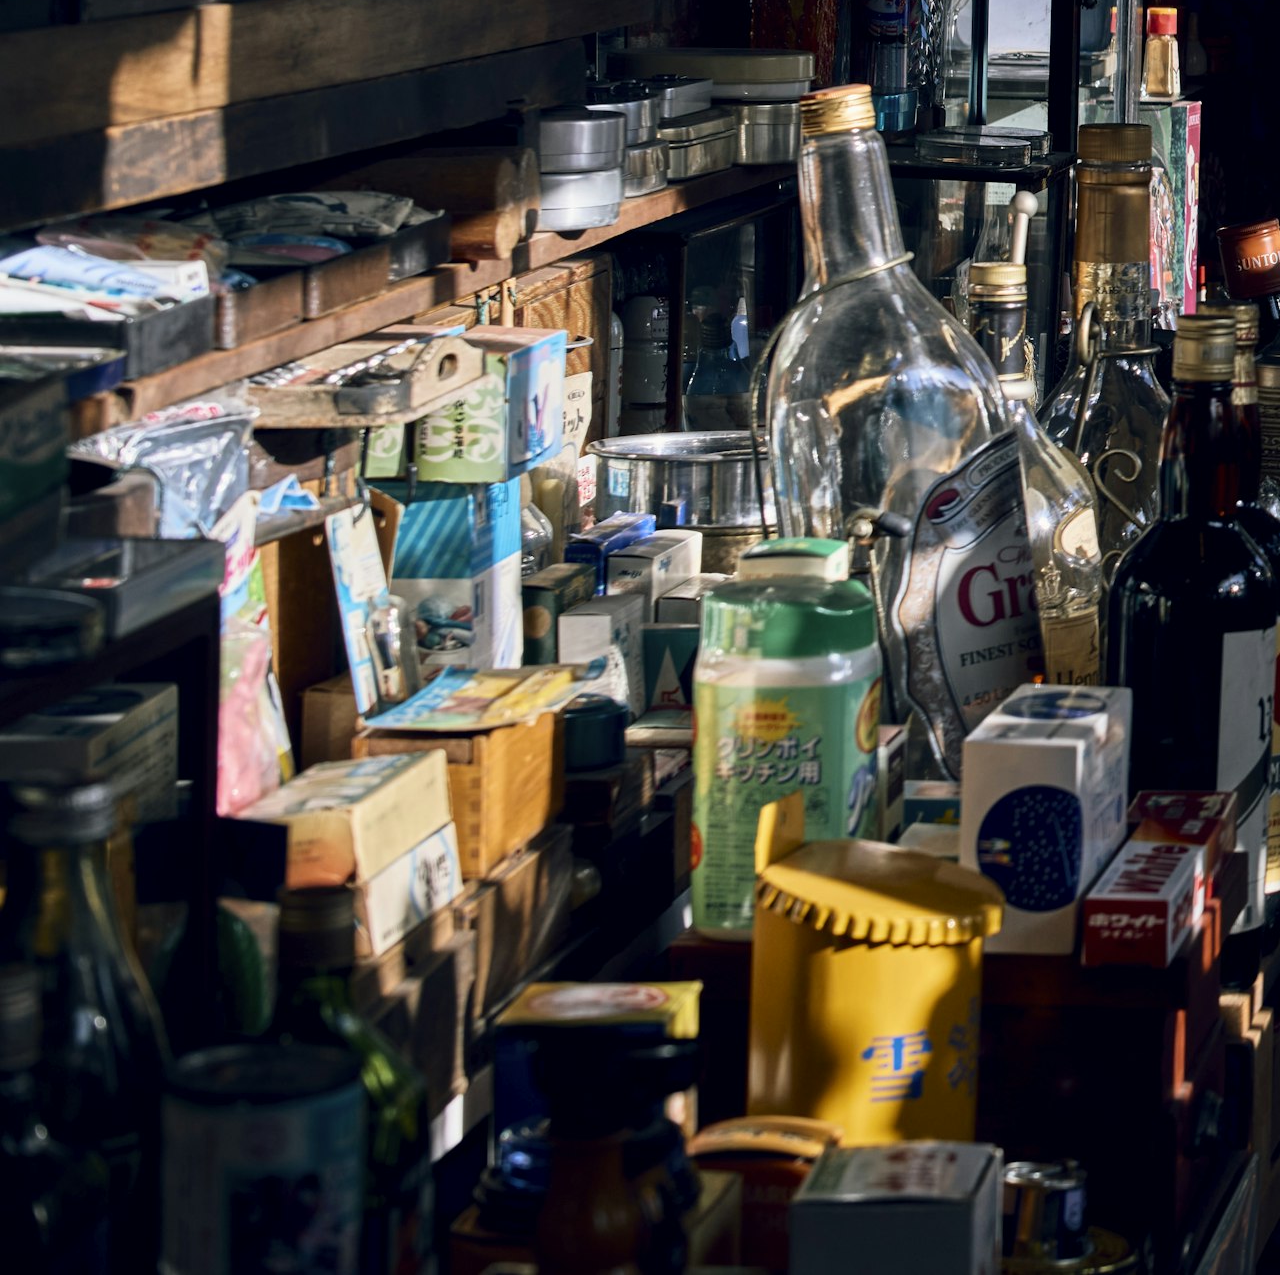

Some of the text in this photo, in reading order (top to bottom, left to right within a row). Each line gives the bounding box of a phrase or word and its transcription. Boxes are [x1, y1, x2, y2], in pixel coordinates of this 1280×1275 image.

[960, 642, 1014, 668] FINEST
[714, 759, 823, 785] キッチン用
[1087, 911, 1166, 929] ホワイト
[861, 1028, 932, 1103] 雪
